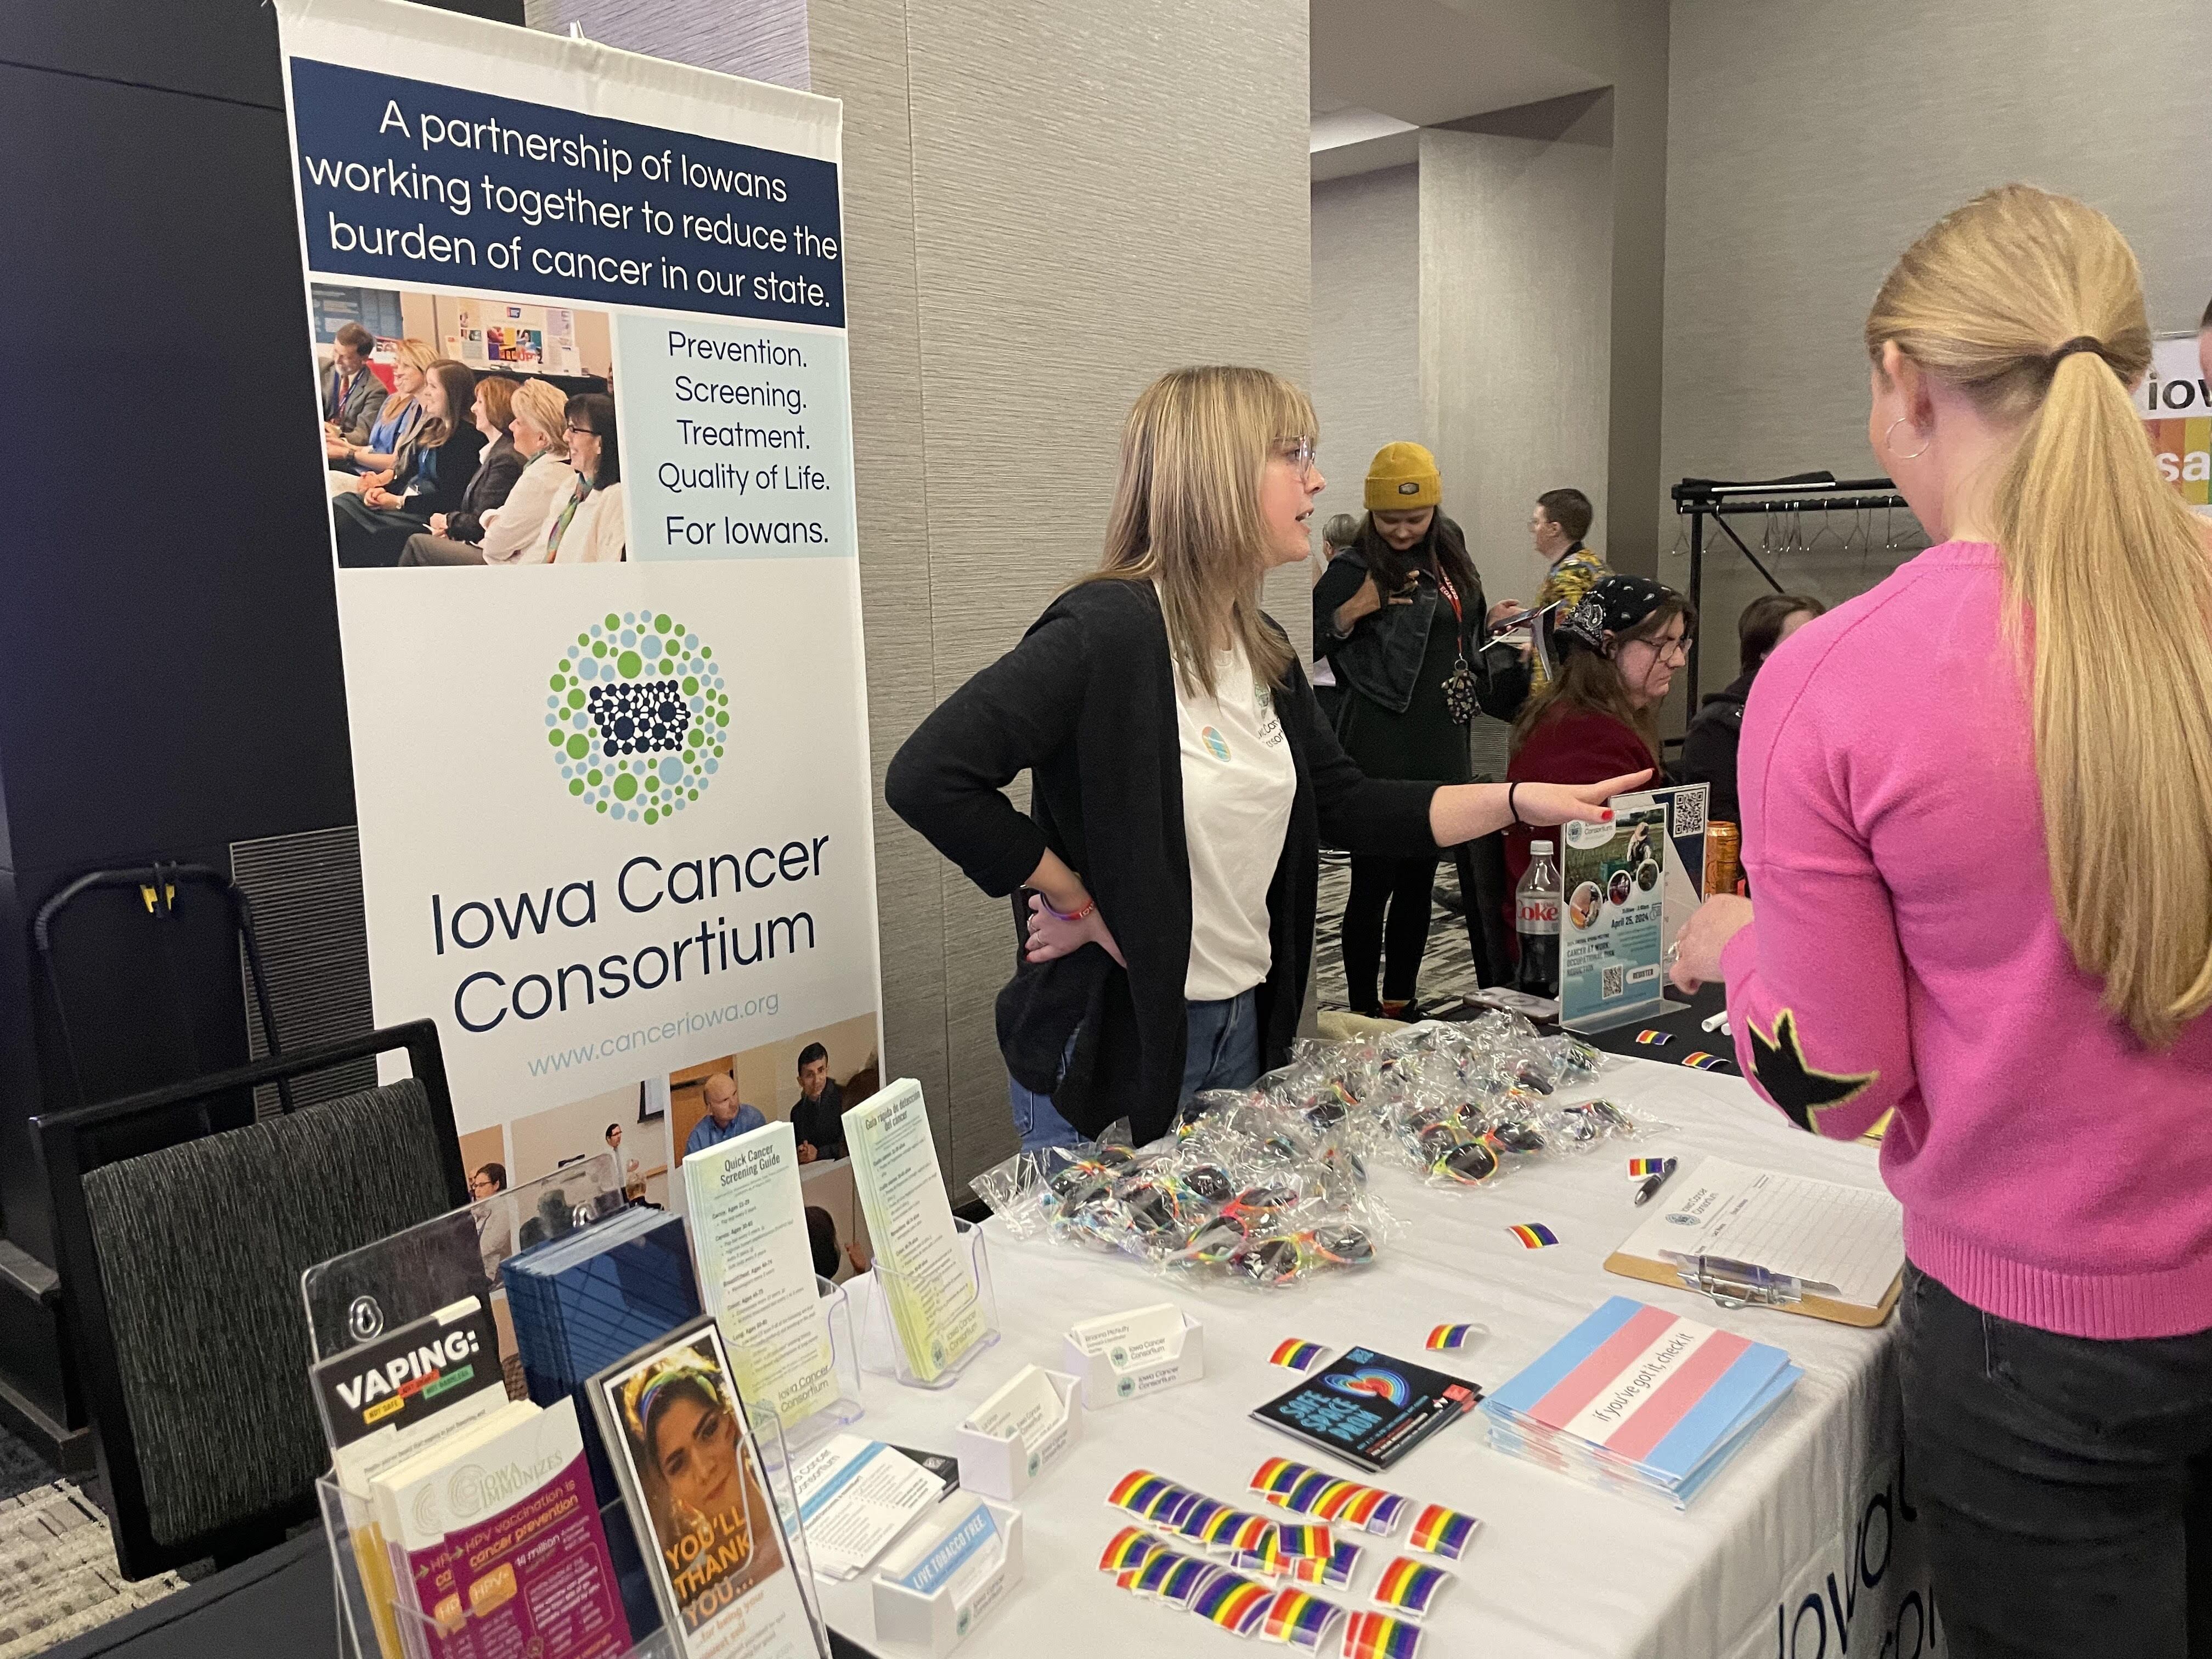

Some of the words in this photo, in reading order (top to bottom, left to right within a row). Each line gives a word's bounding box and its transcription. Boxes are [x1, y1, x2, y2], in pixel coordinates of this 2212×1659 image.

[380, 99, 410, 139] A
[421, 112, 632, 182] partnership
[642, 150, 672, 182] of
[682, 155, 787, 202] Iowans
[305, 155, 471, 215] working
[481, 174, 633, 229] together
[642, 200, 673, 235] to
[682, 213, 786, 253] reduce
[794, 225, 838, 261] the
[329, 212, 476, 266] burden
[487, 235, 522, 270] of
[532, 248, 653, 286] cancer
[661, 257, 686, 291] in
[697, 267, 745, 297] our
[753, 272, 829, 307] state.
[668, 331, 807, 369] Prevention.
[675, 375, 806, 415] Screening.
[677, 419, 810, 450] Treatment.
[658, 461, 748, 497] Quality
[755, 465, 779, 489] of
[786, 464, 830, 492] Life.
[667, 516, 714, 545] For
[725, 515, 829, 544] Iowans.
[432, 879, 597, 955] Iowa
[618, 835, 830, 913] Cancer
[1611, 918, 1624, 929] April
[454, 911, 815, 1033] Consortium
[527, 993, 779, 1077] www.canceriowa.org
[720, 1163, 758, 1187] Screening
[759, 1154, 780, 1171] Guide
[725, 1153, 747, 1172] Quick
[748, 1144, 773, 1161] Cancer
[1656, 1340, 1688, 1363] check
[1675, 1333, 1695, 1341] it
[336, 1330, 479, 1409] VAPING:
[799, 1365, 829, 1387] Cancer
[1633, 1370, 1656, 1388] got
[1643, 1363, 1666, 1373] it,
[1592, 1409, 1612, 1422] if
[1604, 1386, 1640, 1417] you've
[466, 1528, 492, 1552] HPV
[495, 1487, 563, 1533] vaccination
[470, 1534, 512, 1567] cancer
[515, 1494, 579, 1541] prevention
[666, 1505, 747, 1570] YOU'LL
[431, 1552, 452, 1572] HP
[674, 1528, 751, 1599] THANK
[913, 1565, 934, 1589] LIVE
[930, 1532, 966, 1572] TOBACCO
[964, 1514, 986, 1541] FREE
[681, 1576, 754, 1627] YOU...
